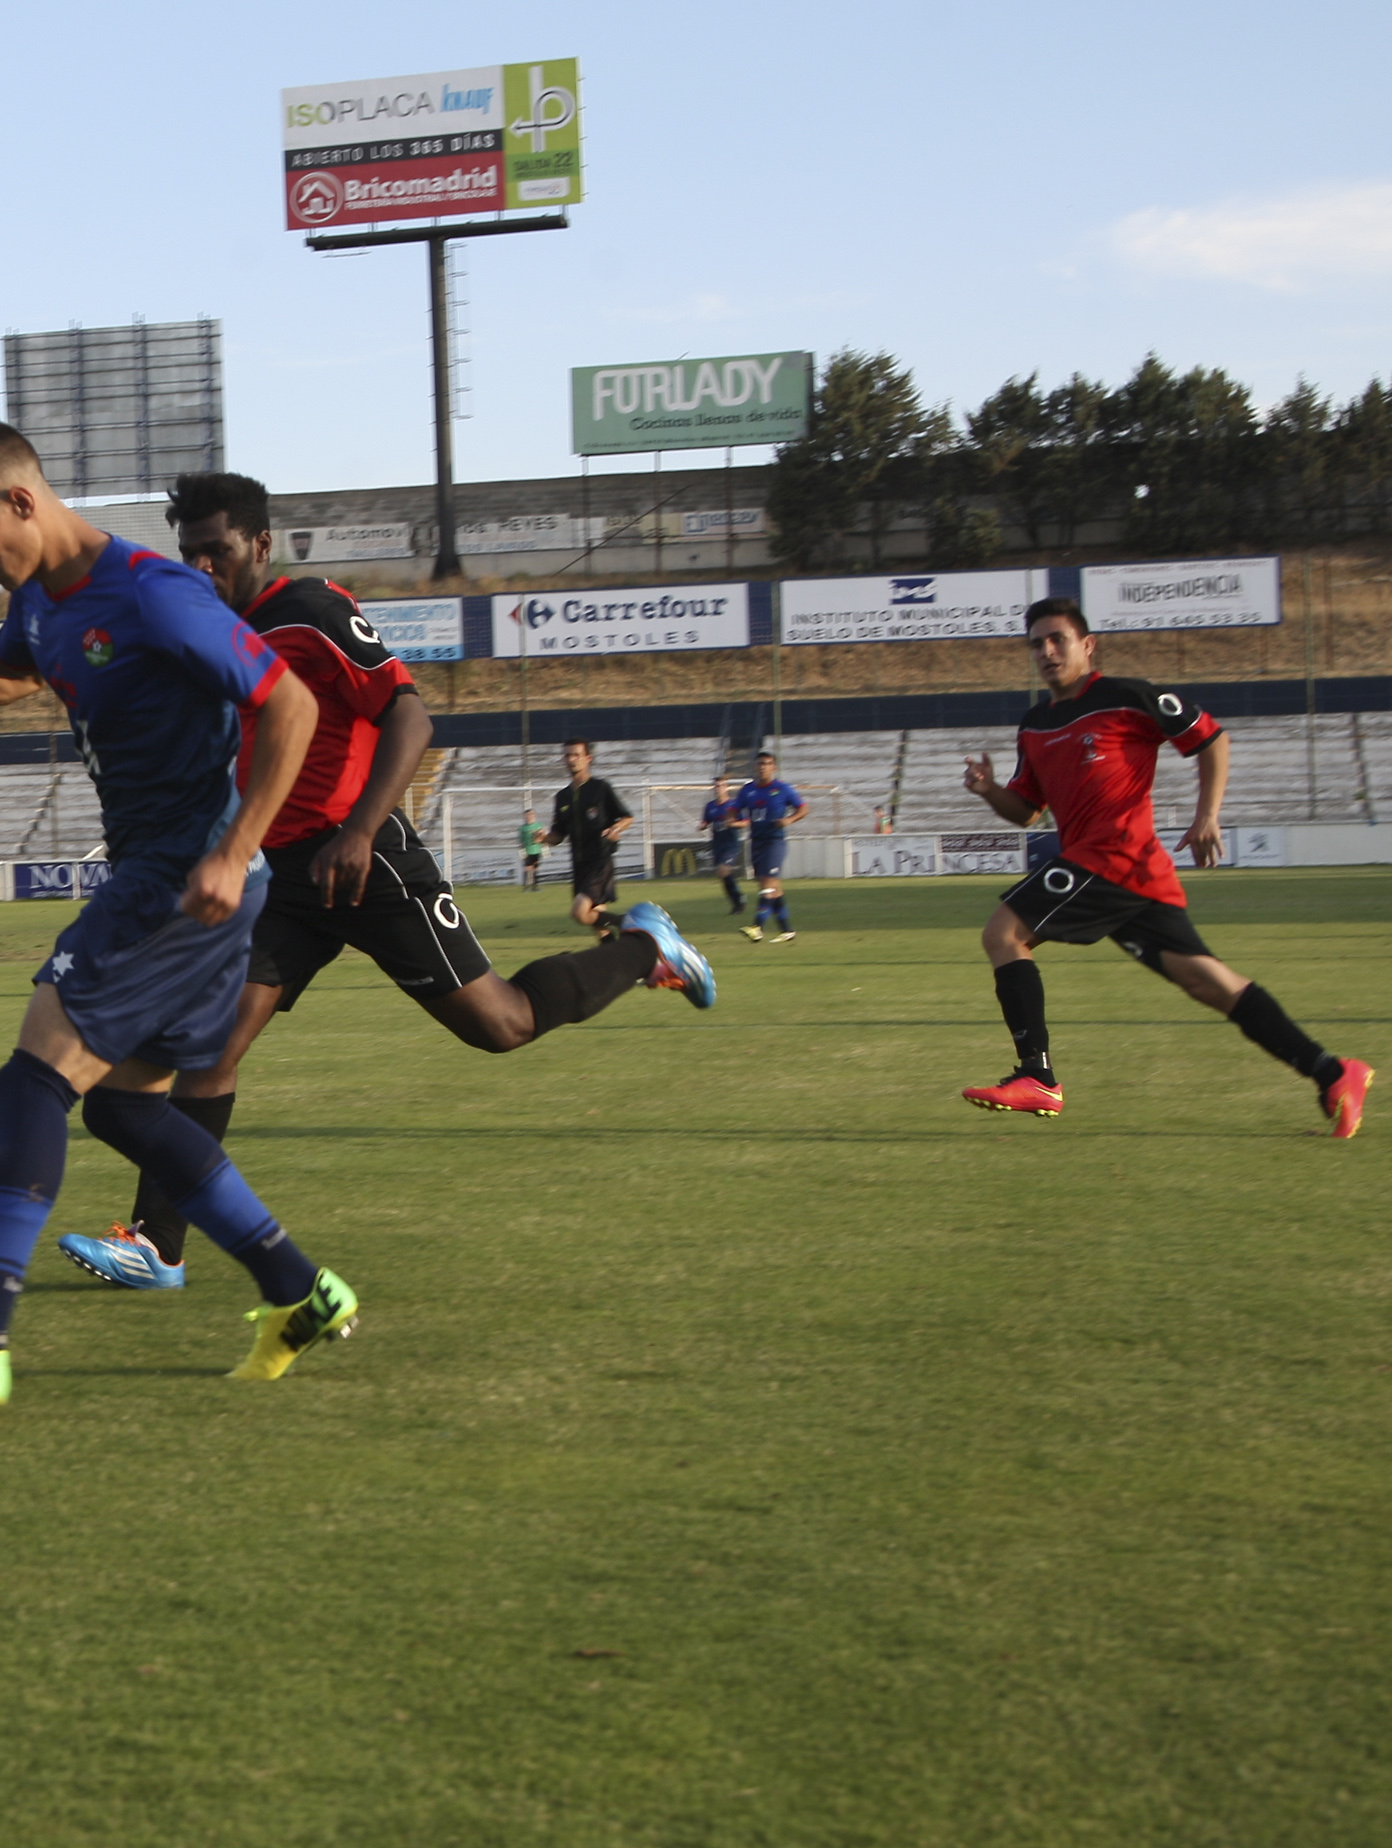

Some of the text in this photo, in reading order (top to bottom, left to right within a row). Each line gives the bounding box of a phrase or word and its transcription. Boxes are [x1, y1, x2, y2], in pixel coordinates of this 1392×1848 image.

[287, 91, 435, 128] ISOPLACA
[291, 132, 495, 167] ABIERTO LOS 365 DÍAS
[554, 151, 573, 168] 22
[344, 165, 497, 201] Bricomadrid
[593, 357, 782, 421] FURLADY
[563, 594, 728, 623] Carrefour
[791, 609, 894, 625] INSTITUTO
[898, 604, 1005, 622] MUNICIPAL
[539, 630, 701, 651] MOSTOLES
[786, 627, 853, 641] SUELO
[855, 625, 884, 639] DE
[853, 850, 1021, 875] LA PRINCESA
